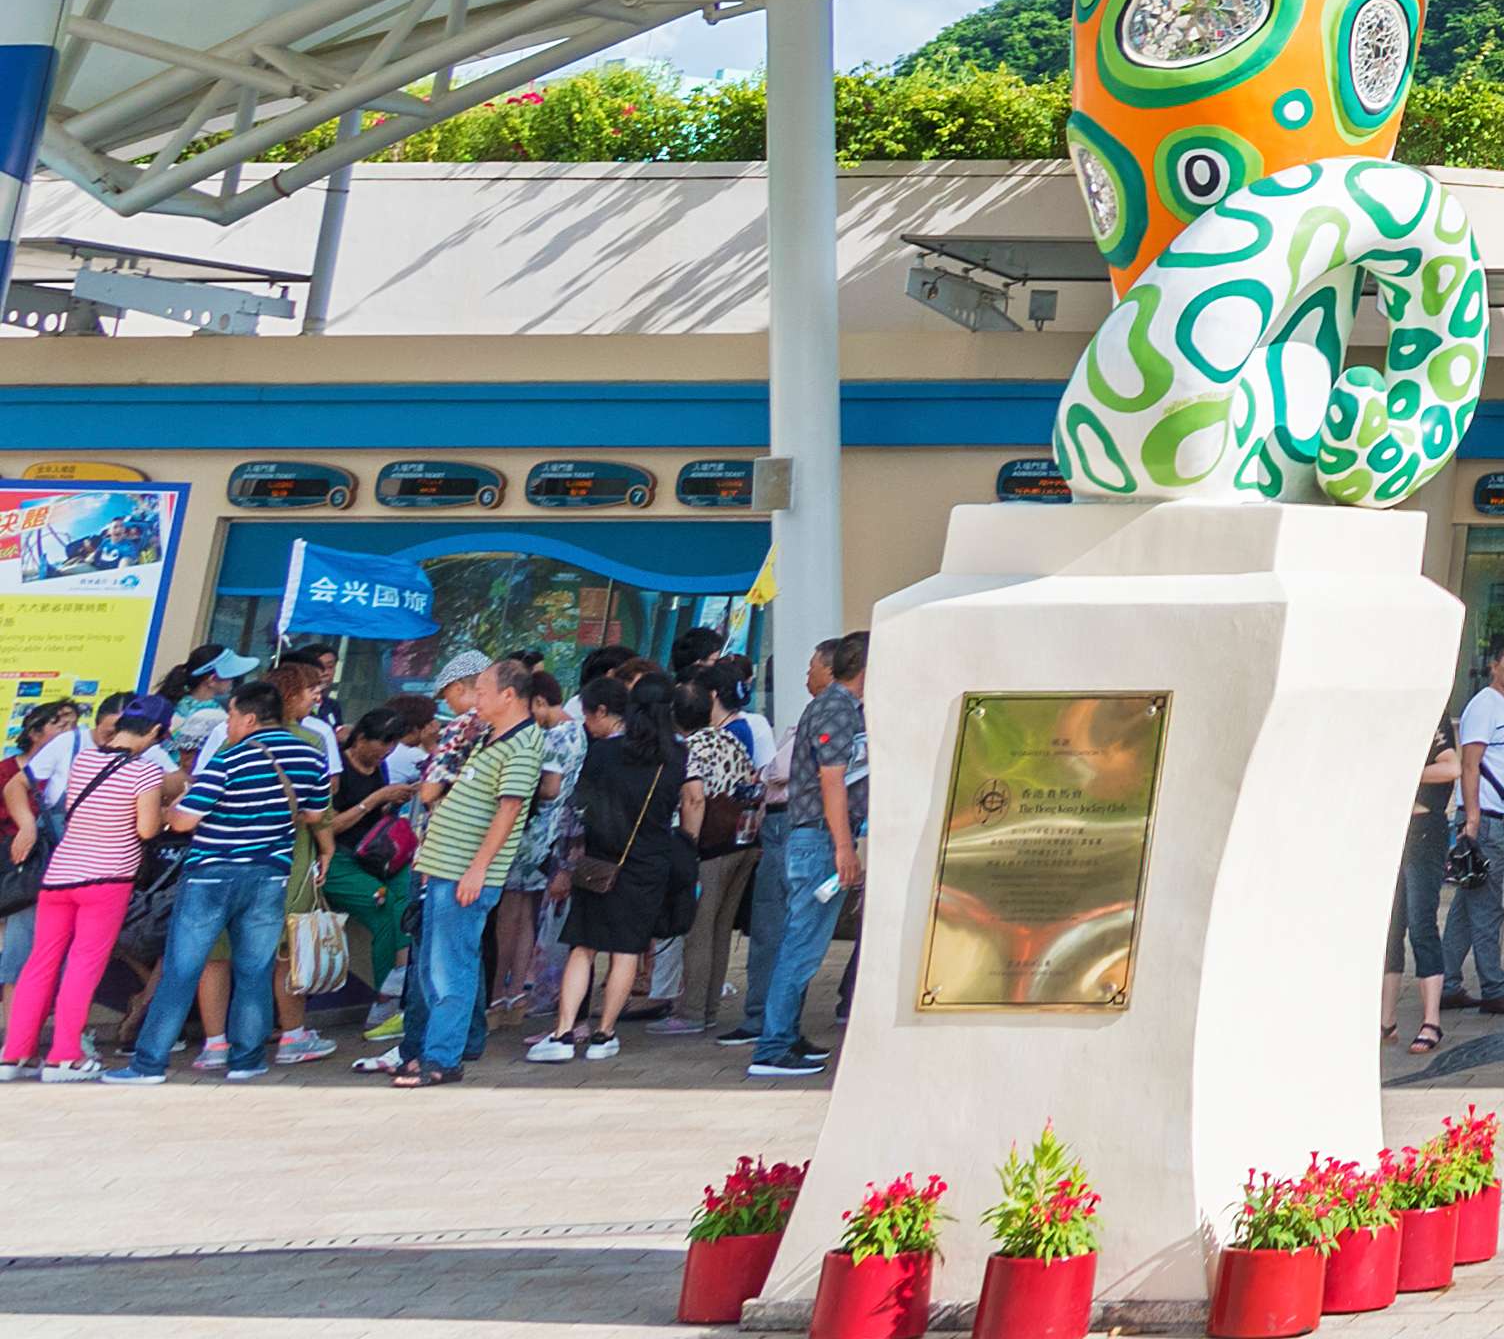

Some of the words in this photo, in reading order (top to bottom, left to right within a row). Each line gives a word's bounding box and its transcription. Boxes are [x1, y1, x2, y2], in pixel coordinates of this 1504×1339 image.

[333, 492, 343, 503] 5
[483, 492, 492, 503] 6
[633, 491, 642, 502] 7
[308, 576, 429, 615] 会兴国旅
